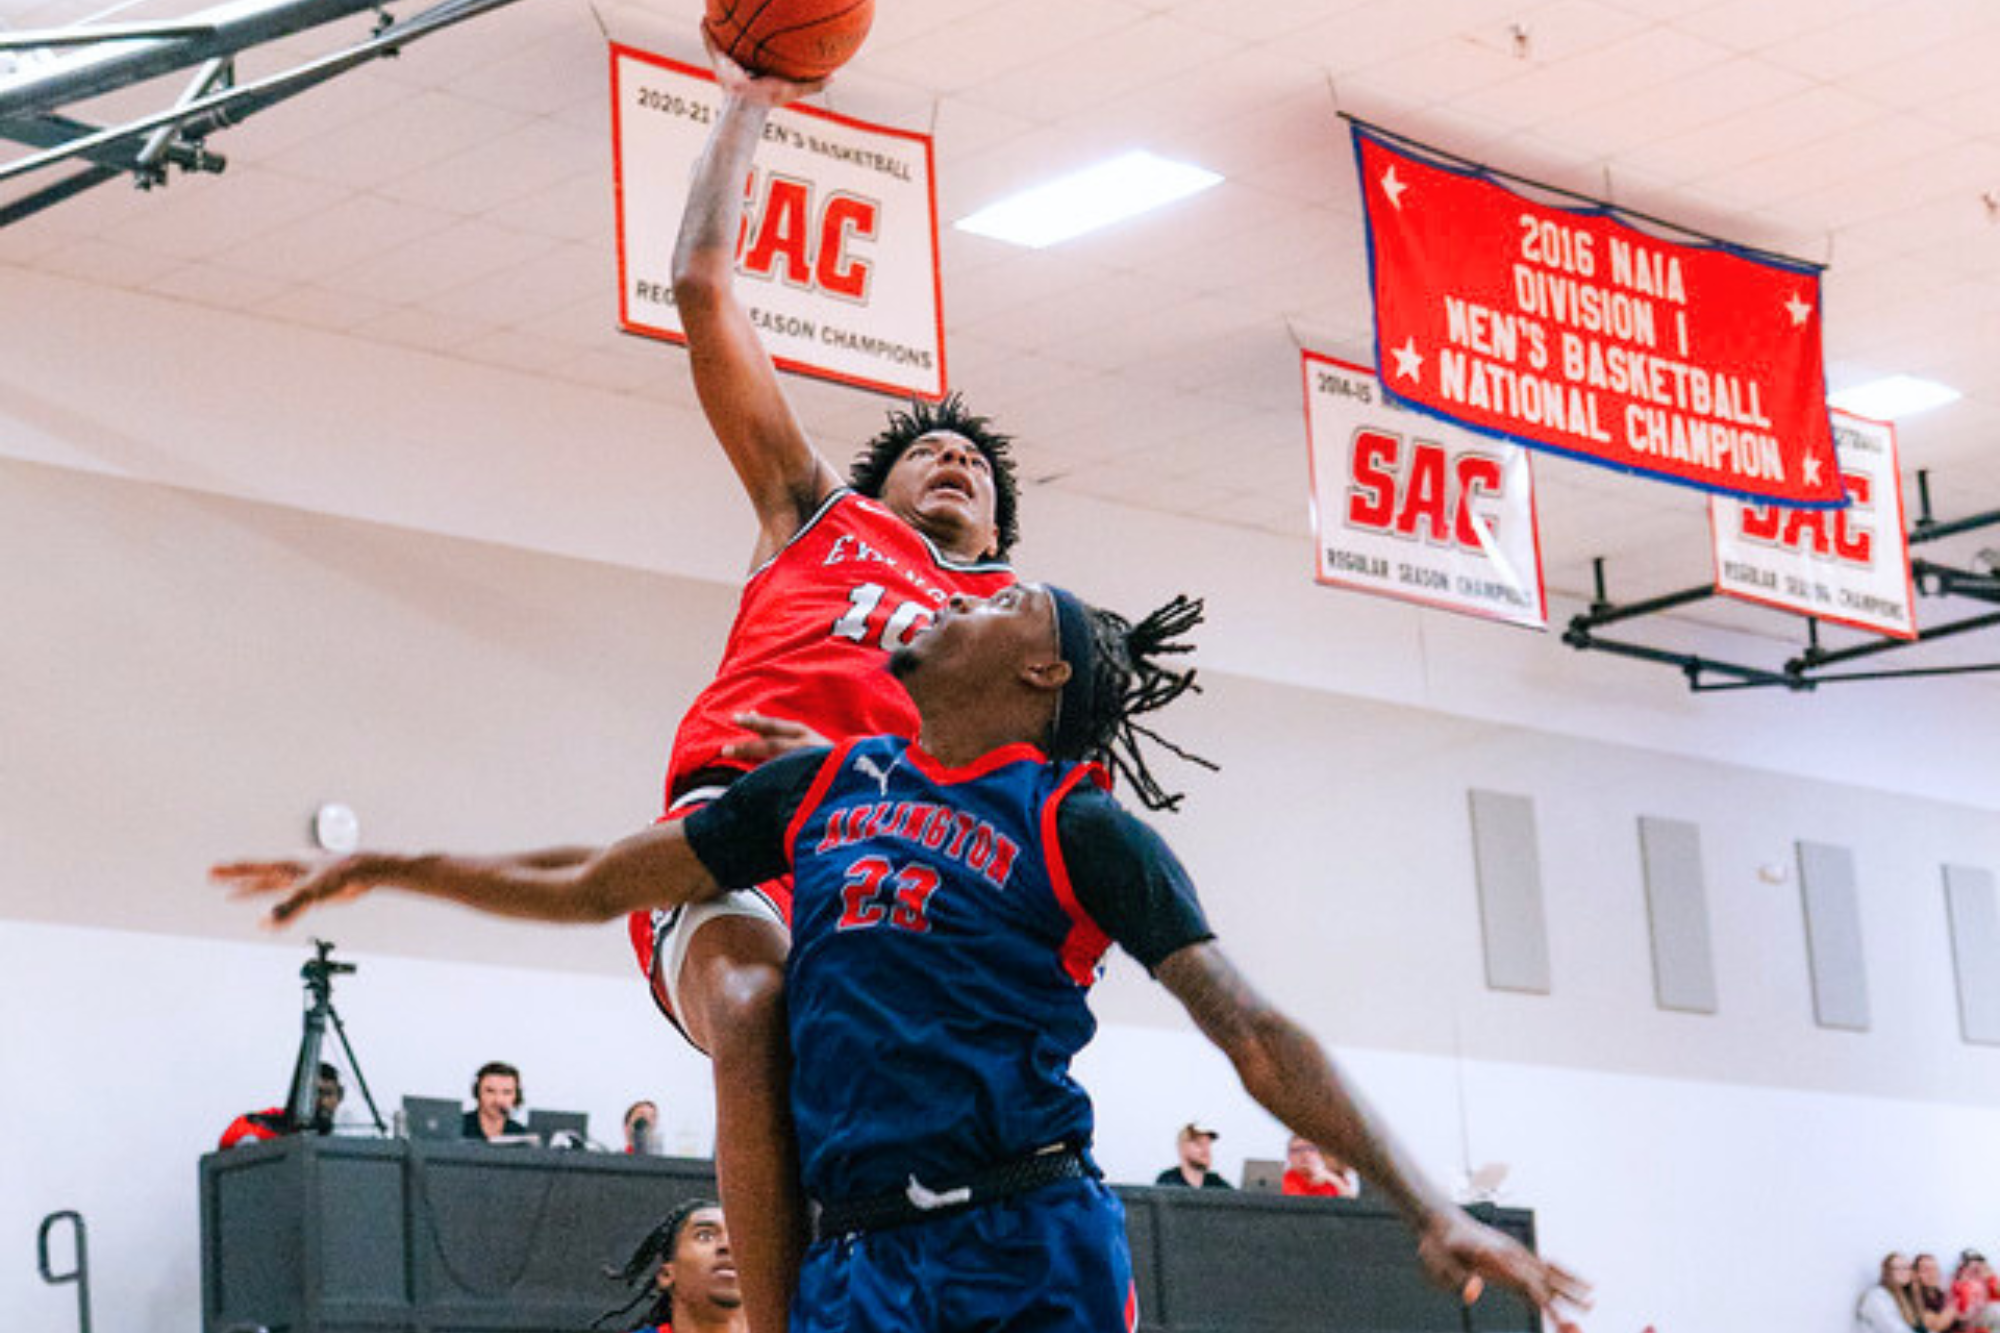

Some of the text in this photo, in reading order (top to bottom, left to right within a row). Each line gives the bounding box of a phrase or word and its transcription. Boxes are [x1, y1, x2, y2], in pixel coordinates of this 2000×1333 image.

[637, 87, 710, 124] 2020-21
[808, 135, 911, 182] BASKETBALL
[735, 168, 880, 305] AC
[1519, 214, 1687, 304] 2016 NAIA
[751, 308, 934, 371] EASON CHAMPIONS
[1514, 264, 1689, 357] DIVISION I
[1444, 296, 1770, 428] MEN'S BASKETBALL
[1440, 348, 1785, 483] NATIONAL CHAMPION
[1346, 426, 1503, 555] SAC
[1399, 563, 1450, 590] SEASON
[815, 801, 1020, 891] ARLINGTON
[836, 855, 941, 932] 23
